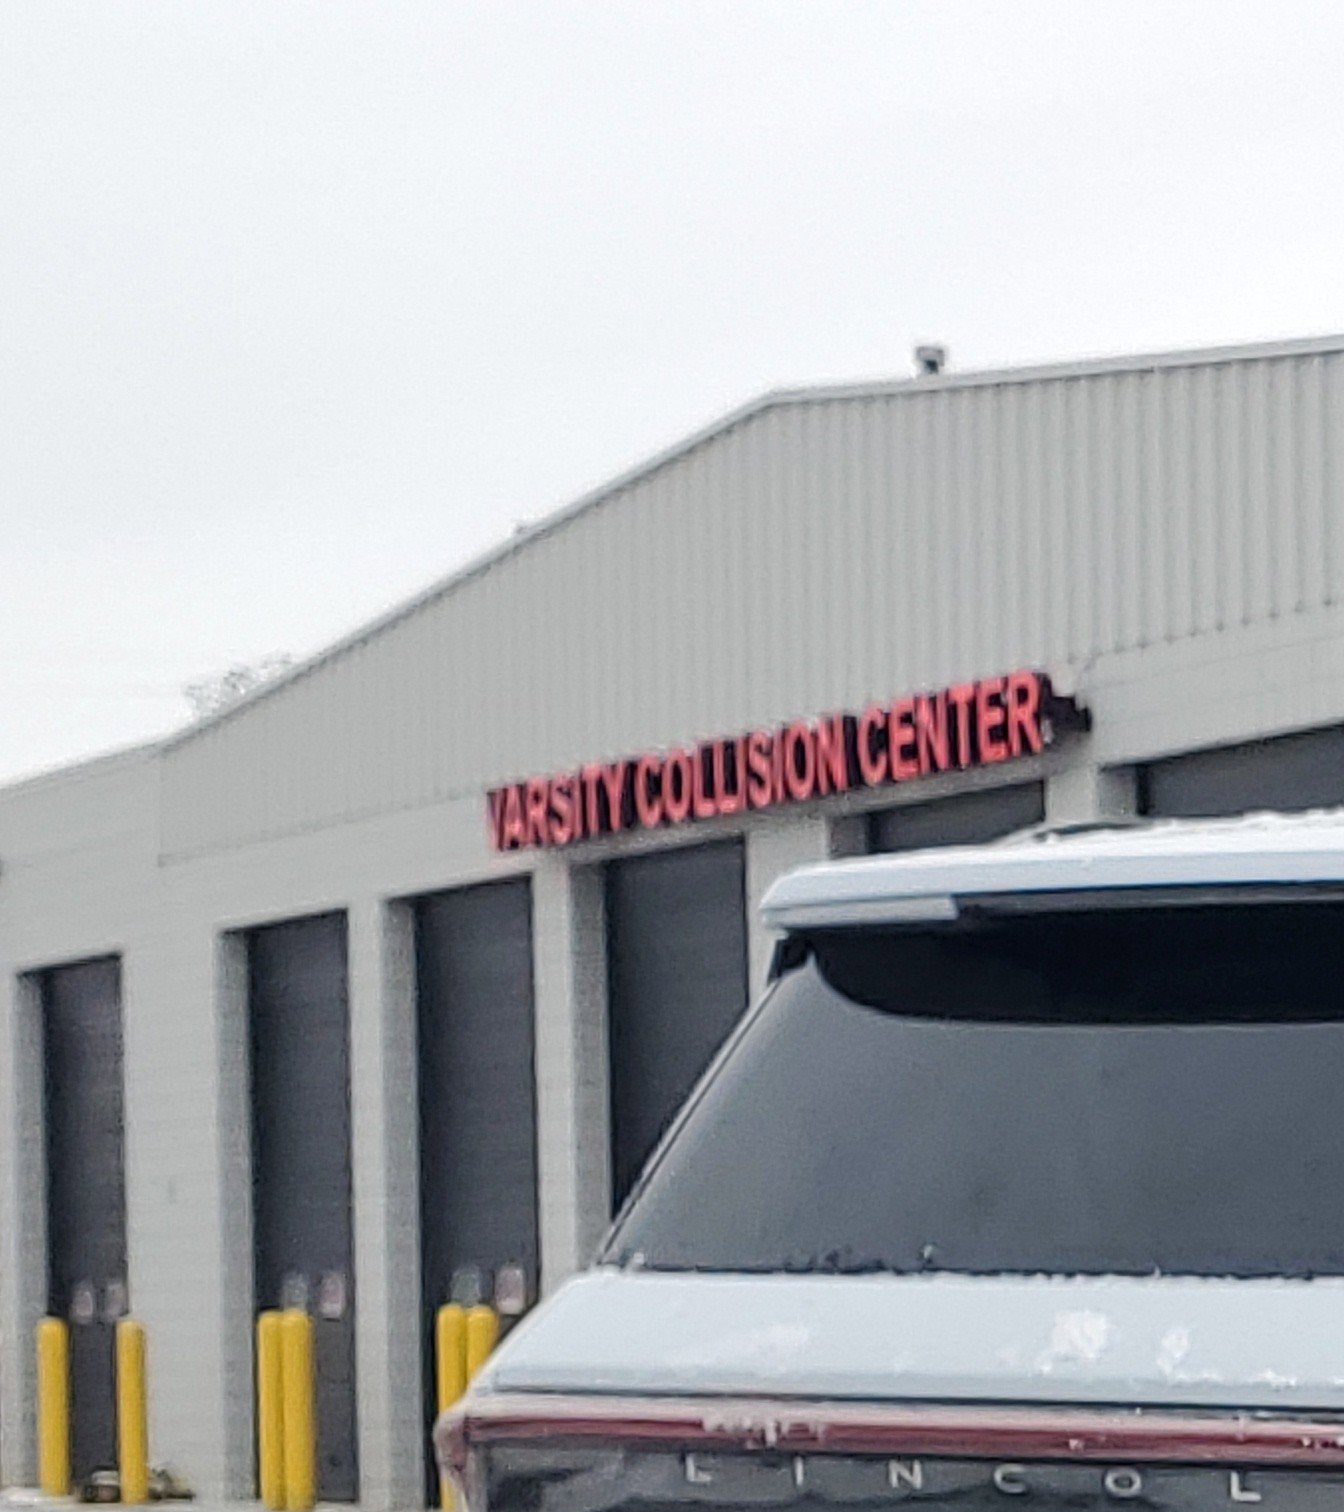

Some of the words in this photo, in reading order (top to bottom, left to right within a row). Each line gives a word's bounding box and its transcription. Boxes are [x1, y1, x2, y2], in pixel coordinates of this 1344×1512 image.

[487, 761, 630, 851] VARSITY
[635, 715, 847, 829] COLLISION
[857, 669, 1043, 783] CENTER
